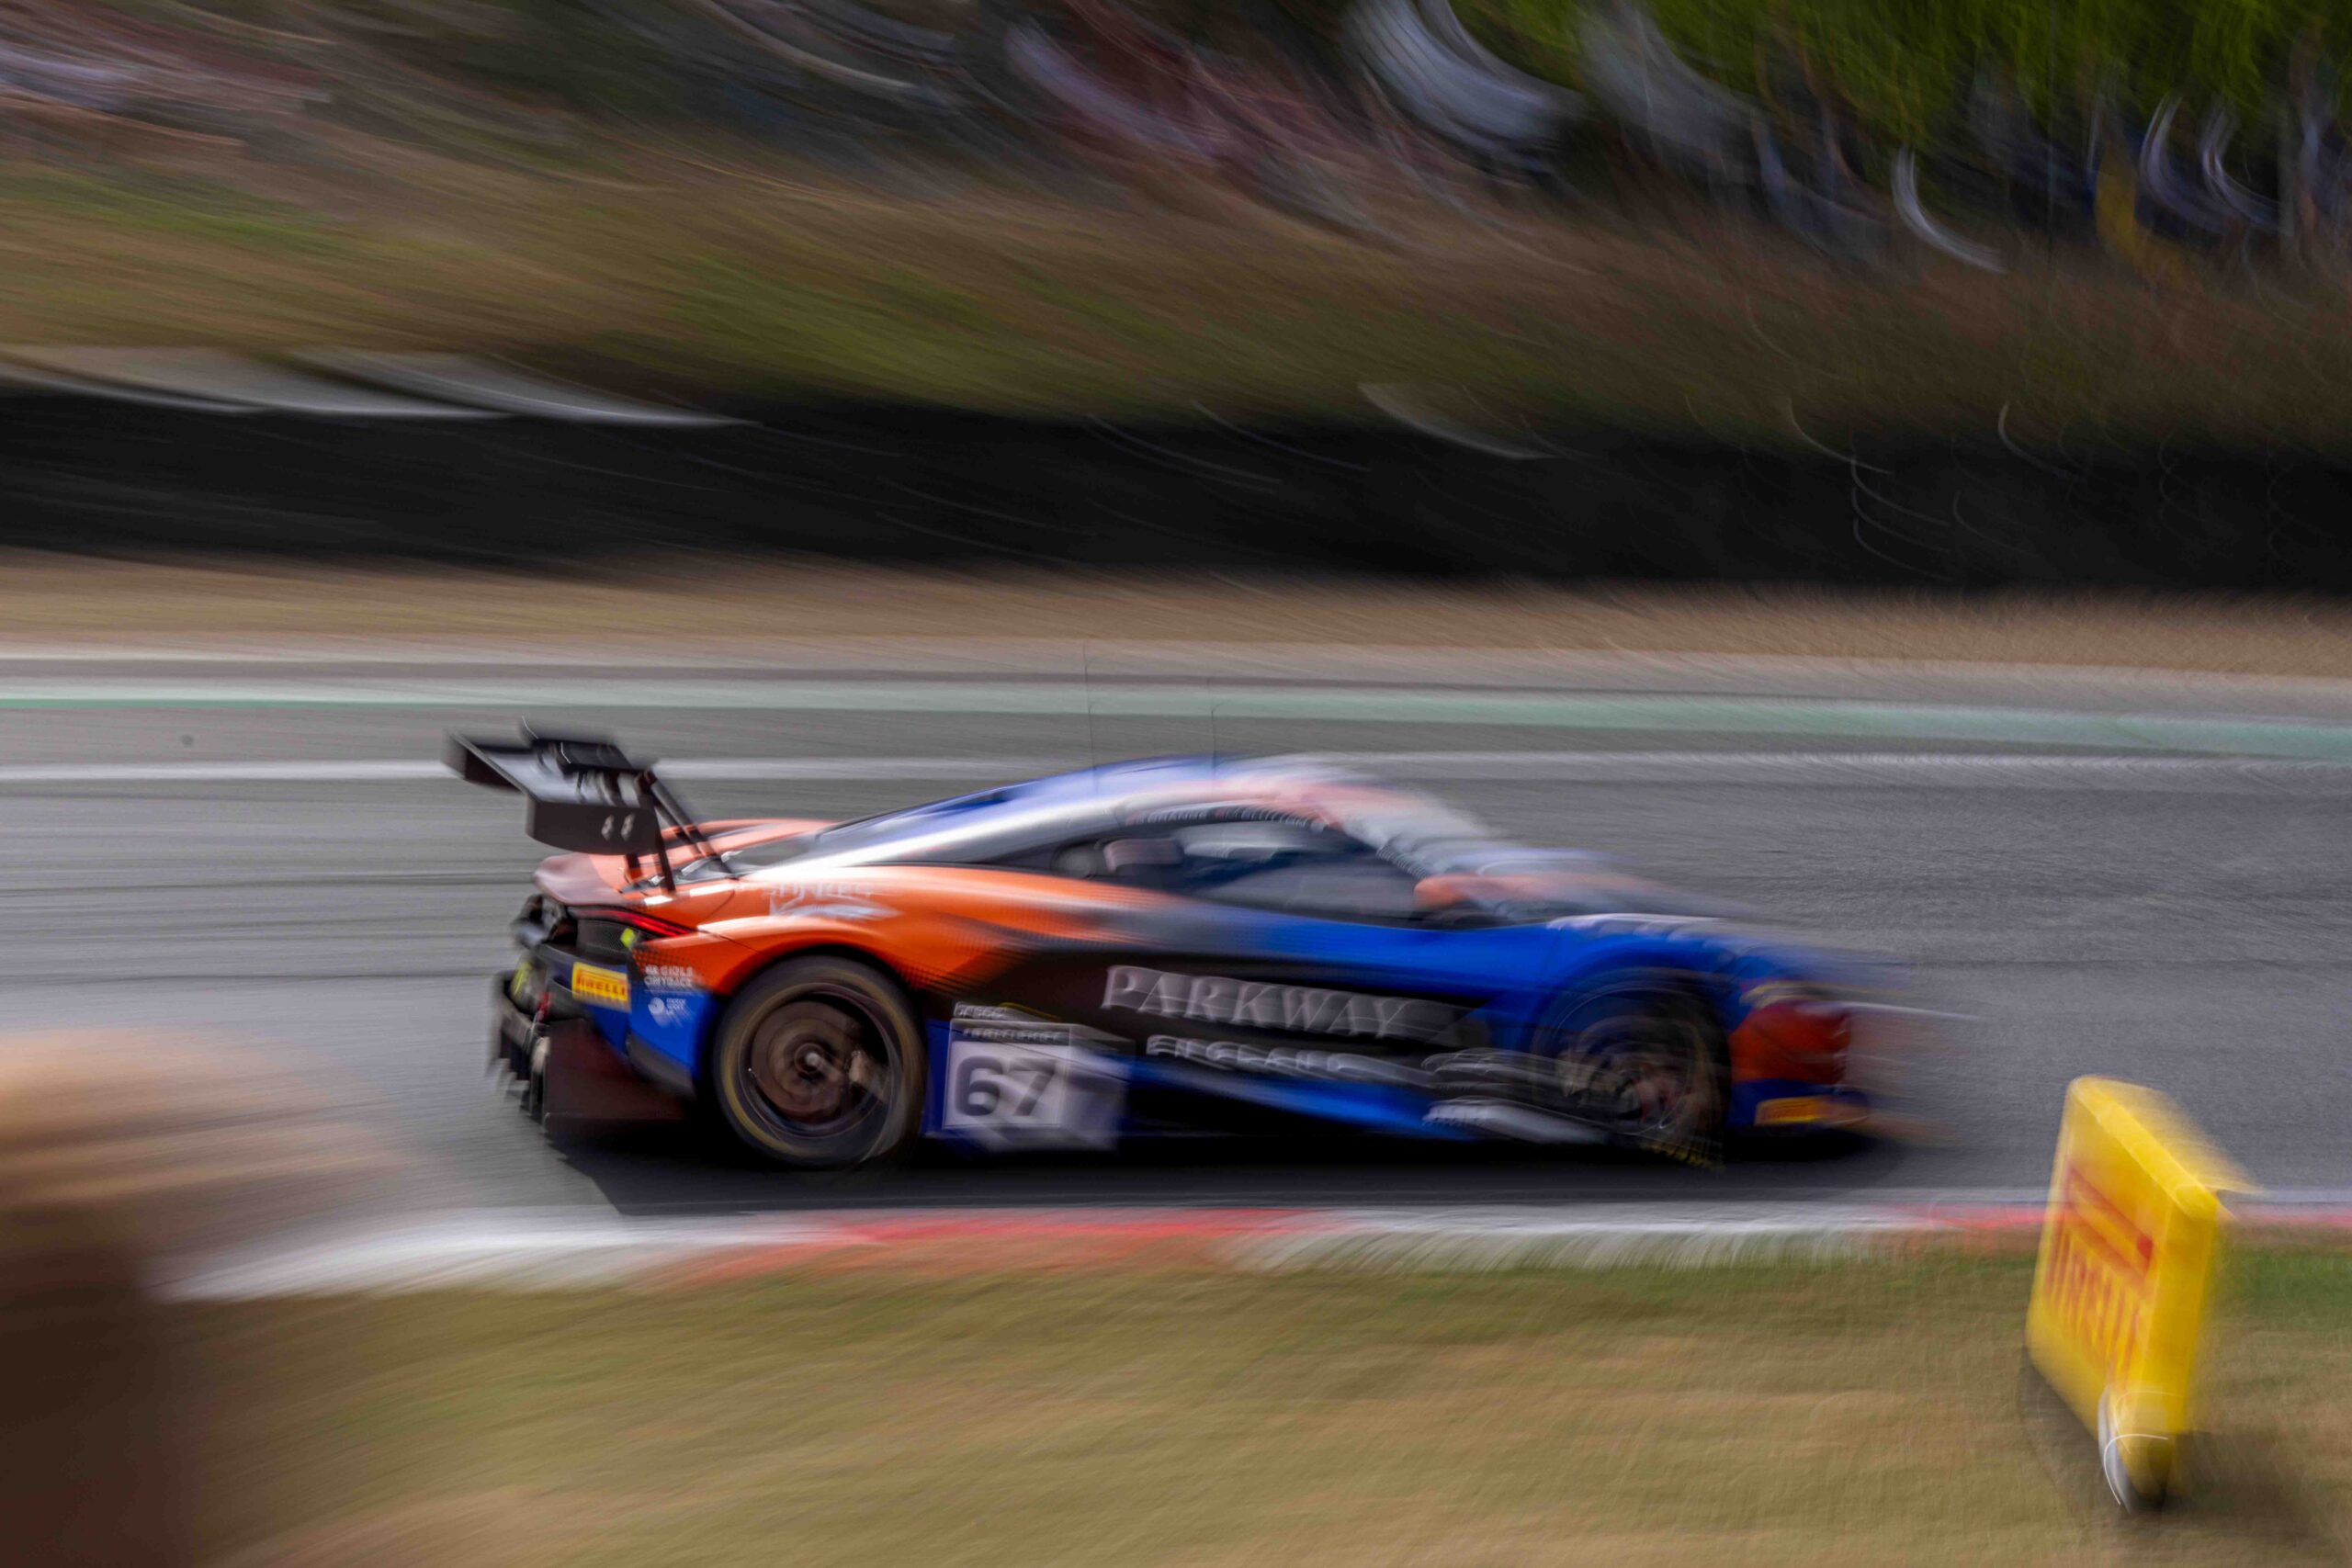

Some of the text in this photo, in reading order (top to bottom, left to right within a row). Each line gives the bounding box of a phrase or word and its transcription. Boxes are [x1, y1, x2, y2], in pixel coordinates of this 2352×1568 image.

[577, 970, 627, 997] PIRELLI
[1102, 965, 1419, 1039] PARKWAY
[955, 1056, 1057, 1117] 67
